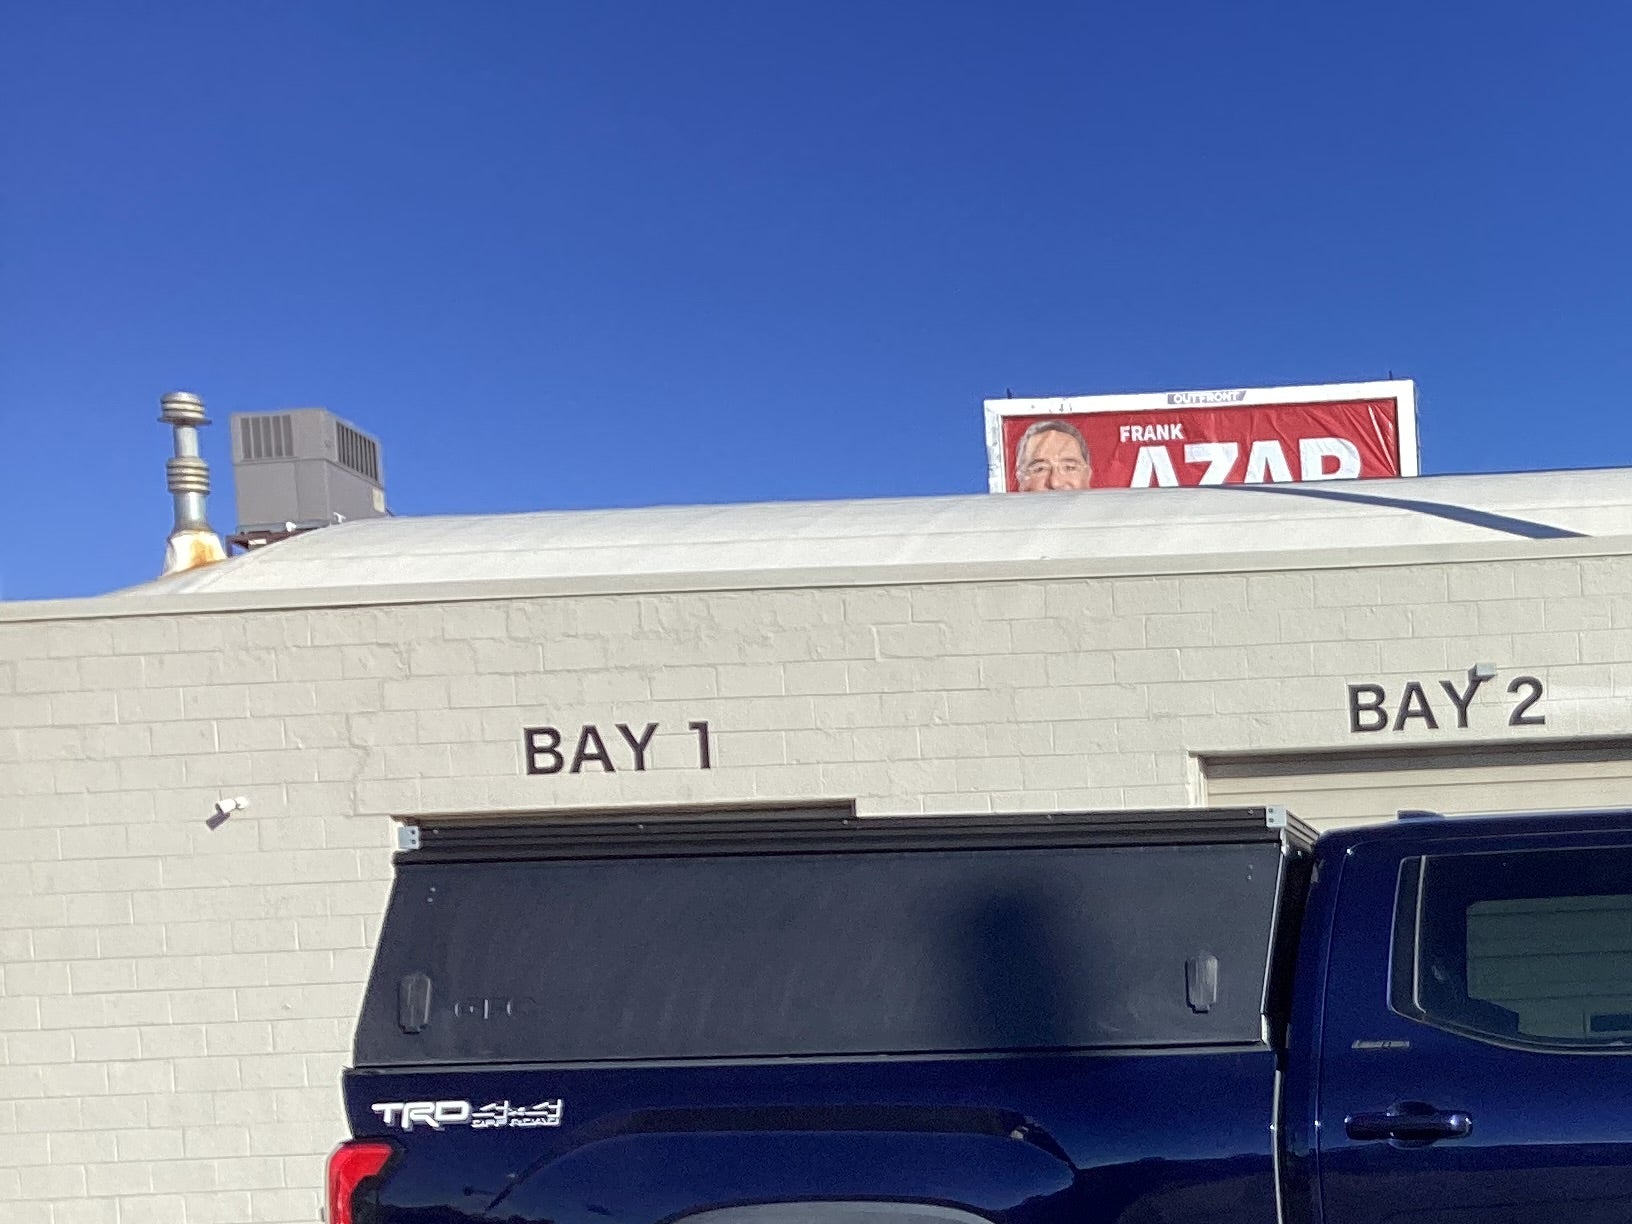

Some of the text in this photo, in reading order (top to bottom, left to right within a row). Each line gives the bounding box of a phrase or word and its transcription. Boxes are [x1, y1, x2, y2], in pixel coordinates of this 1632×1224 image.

[1173, 391, 1240, 404] OUTFRONT
[1119, 423, 1184, 443] FRANK
[1348, 676, 1545, 733] BAY 2
[523, 721, 711, 775] BAY 1
[371, 1100, 474, 1130] TRD
